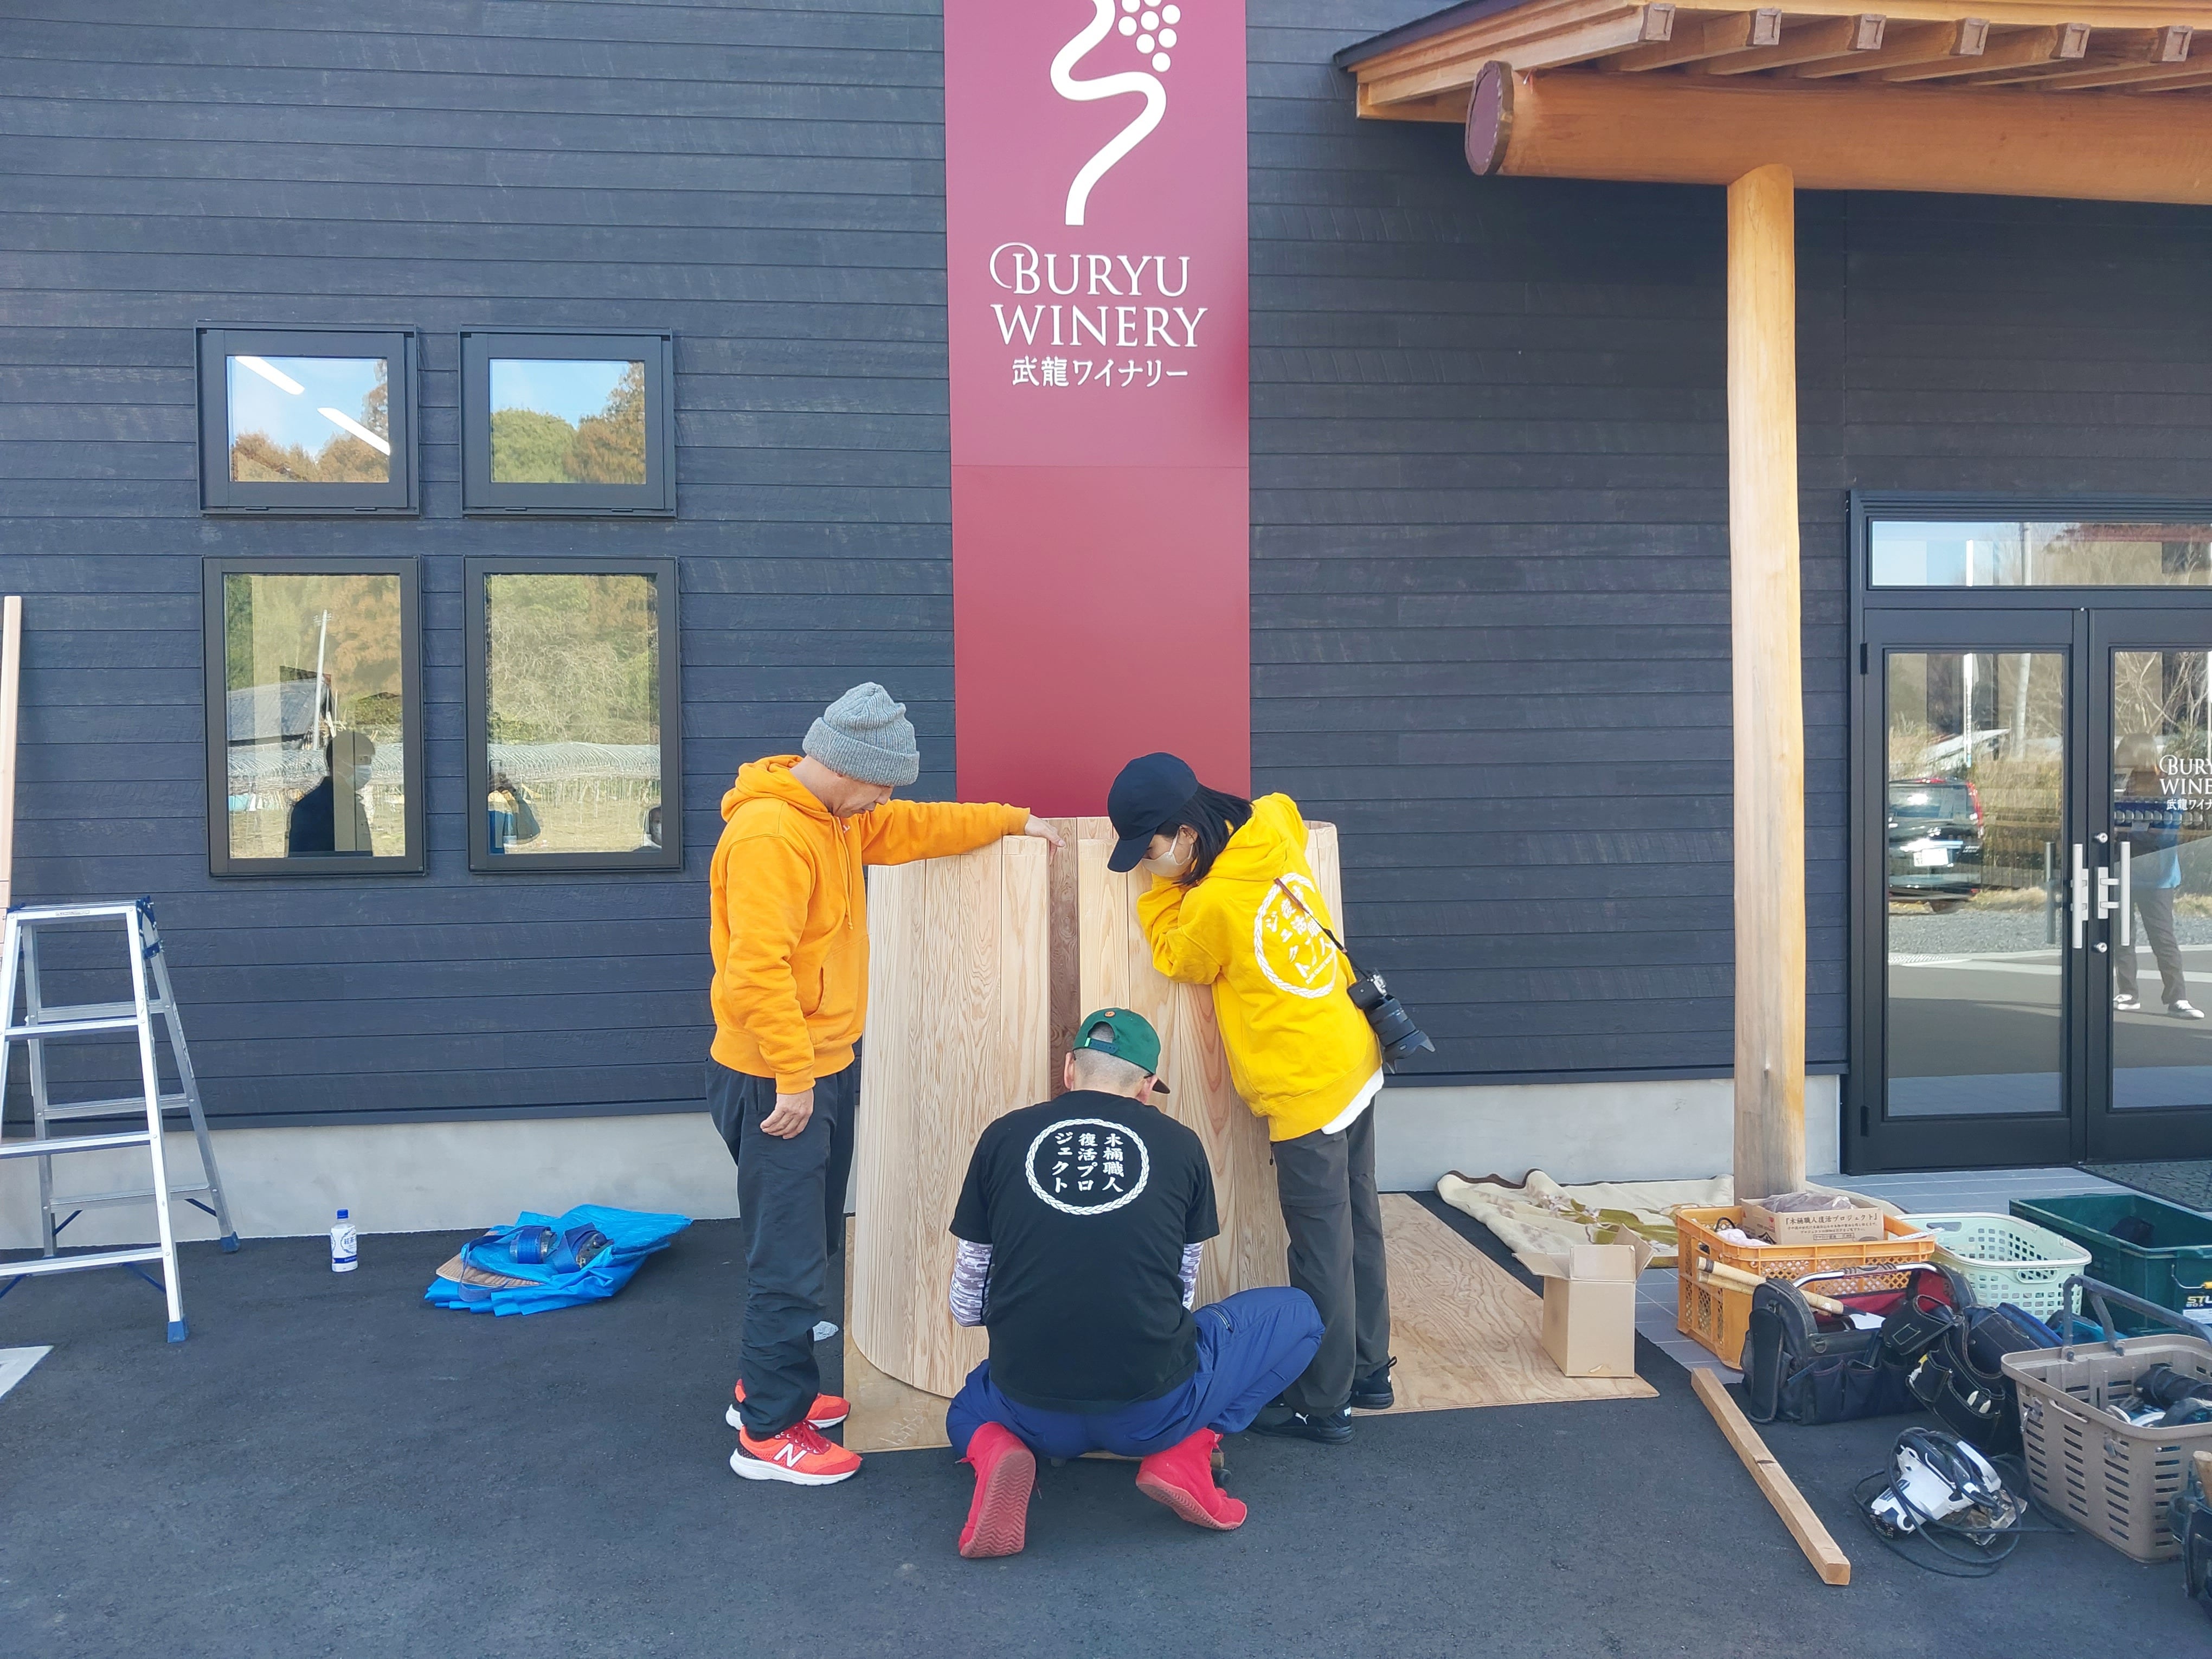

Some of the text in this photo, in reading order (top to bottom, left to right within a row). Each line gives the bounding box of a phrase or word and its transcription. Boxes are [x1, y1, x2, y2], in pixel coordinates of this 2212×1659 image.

[989, 242, 1191, 297] BURYU
[989, 304, 1208, 348] WINERY
[1012, 355, 1188, 387] 武龍ワイナリー
[1051, 1131, 1073, 1193] ジェクト
[1077, 1132, 1098, 1192] 復活プロ
[1102, 1133, 1125, 1193] 木桶職人
[773, 1443, 807, 1468] N
